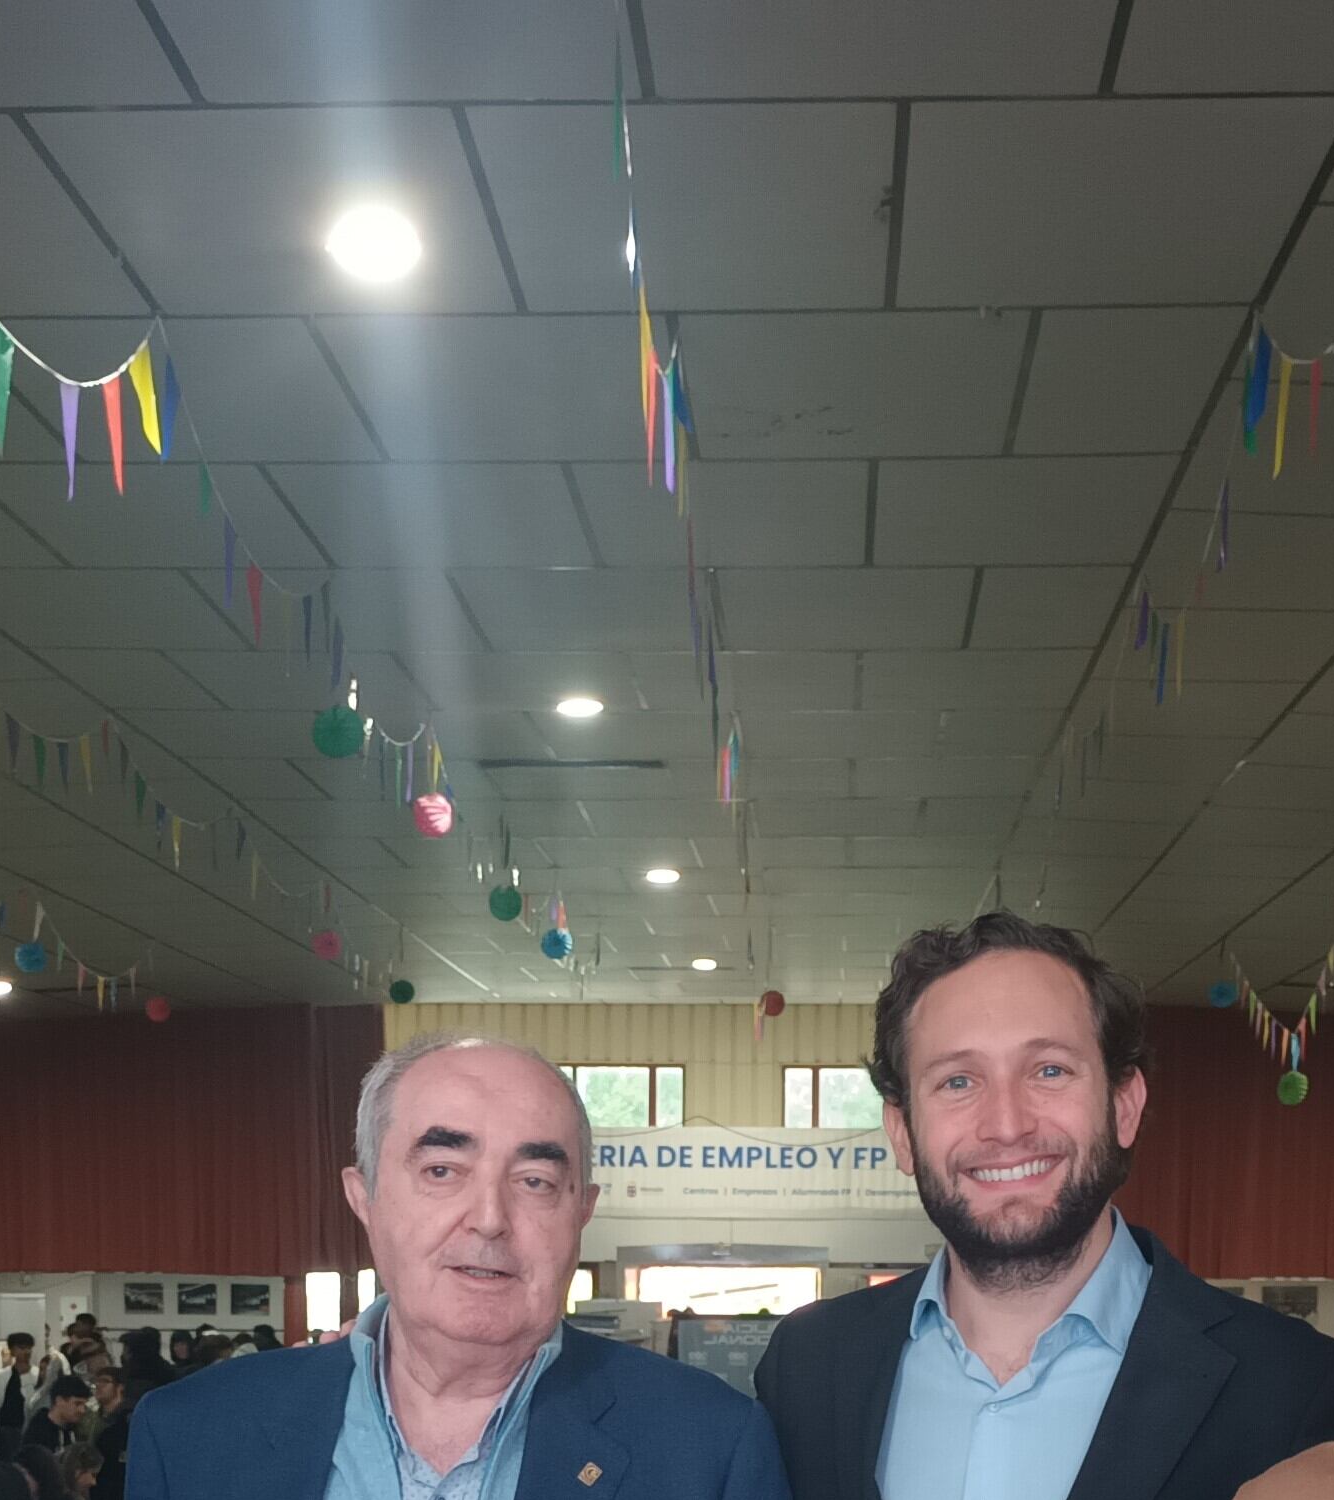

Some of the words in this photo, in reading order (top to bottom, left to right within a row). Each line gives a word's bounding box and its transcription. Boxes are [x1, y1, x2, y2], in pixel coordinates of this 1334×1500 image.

[656, 1144, 694, 1169] DE
[701, 1145, 818, 1170] EMPLEO
[826, 1146, 845, 1170] Y
[853, 1147, 888, 1170] FP
